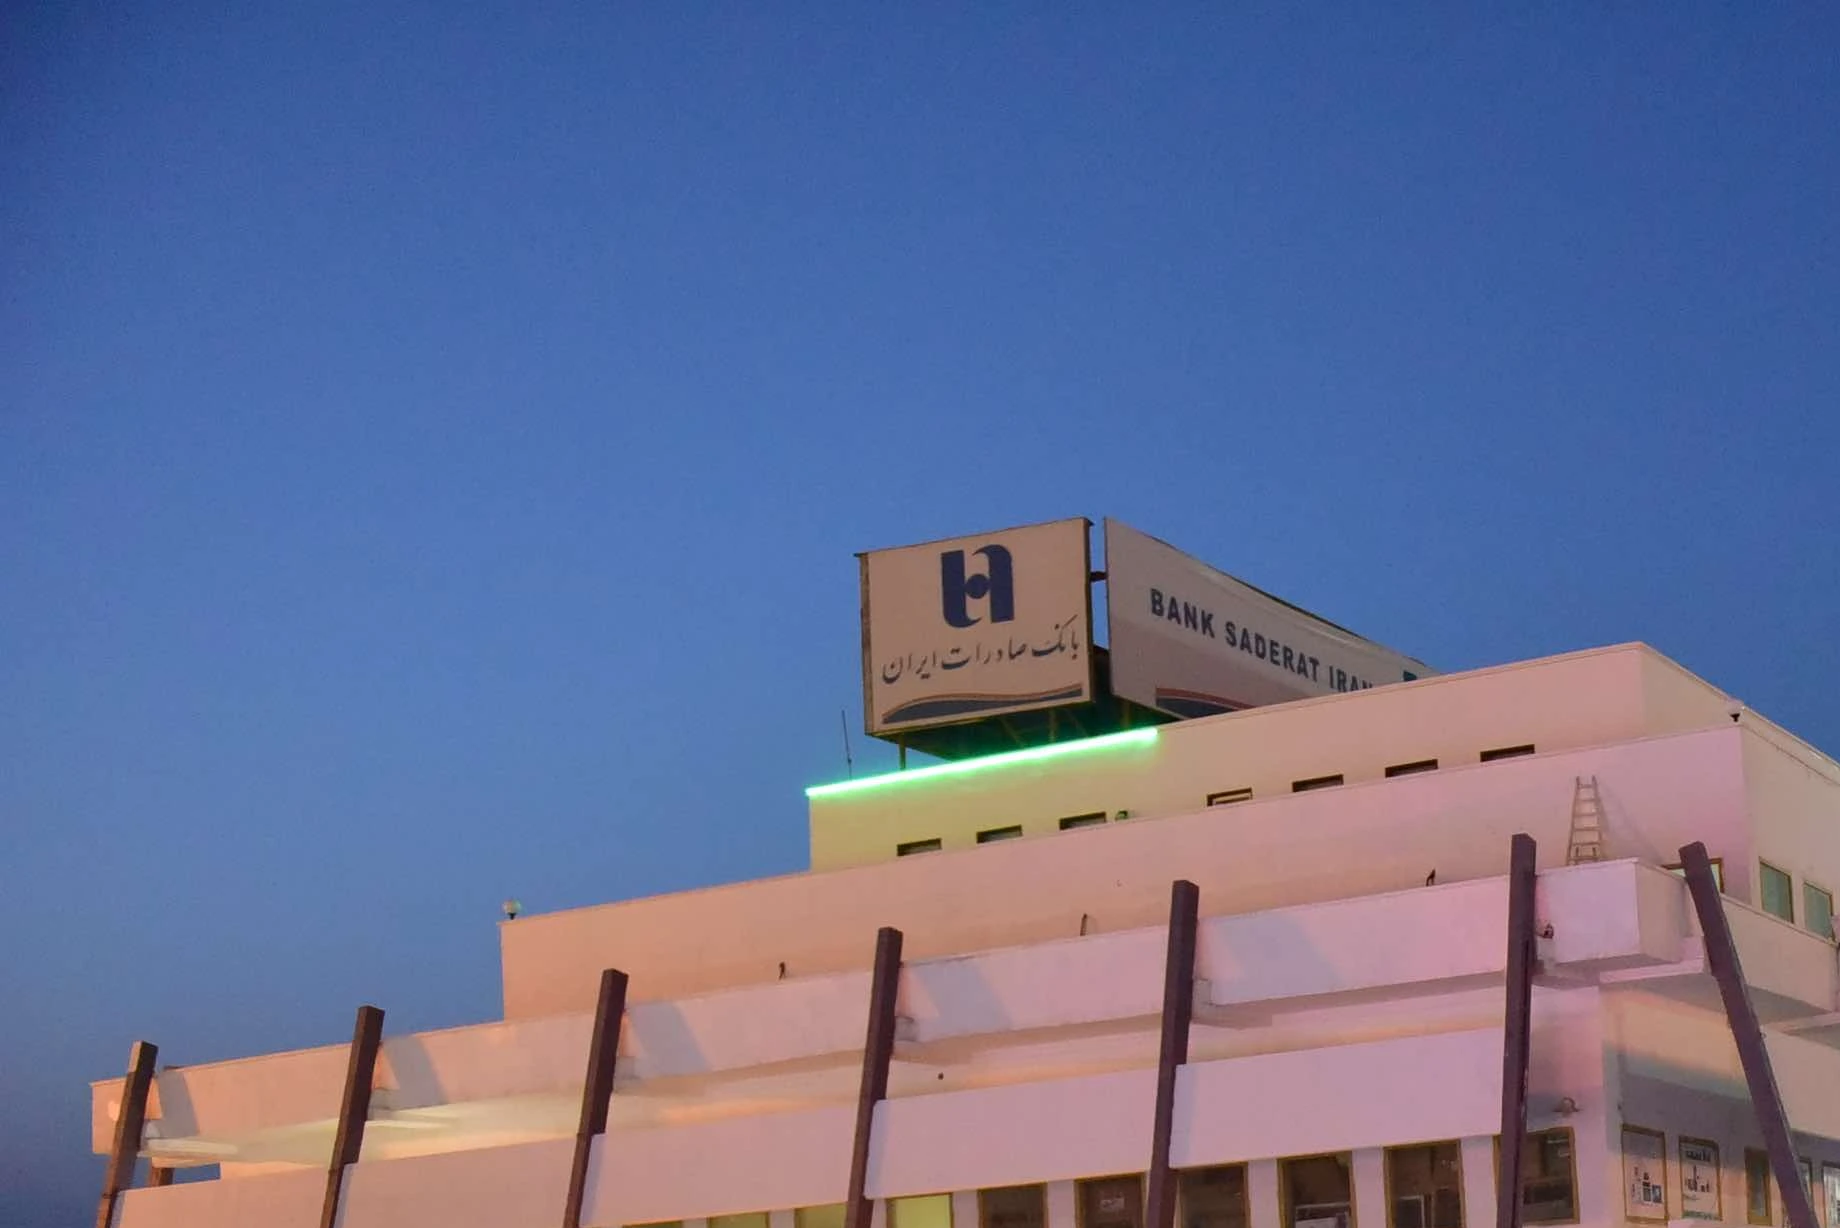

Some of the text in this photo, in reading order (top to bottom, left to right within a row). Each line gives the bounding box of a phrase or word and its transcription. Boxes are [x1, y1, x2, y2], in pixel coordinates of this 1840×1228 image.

[882, 614, 1080, 684] بانک صادرات ایران
[1151, 588, 1215, 639] BANK
[1225, 621, 1320, 683] SADERAT
